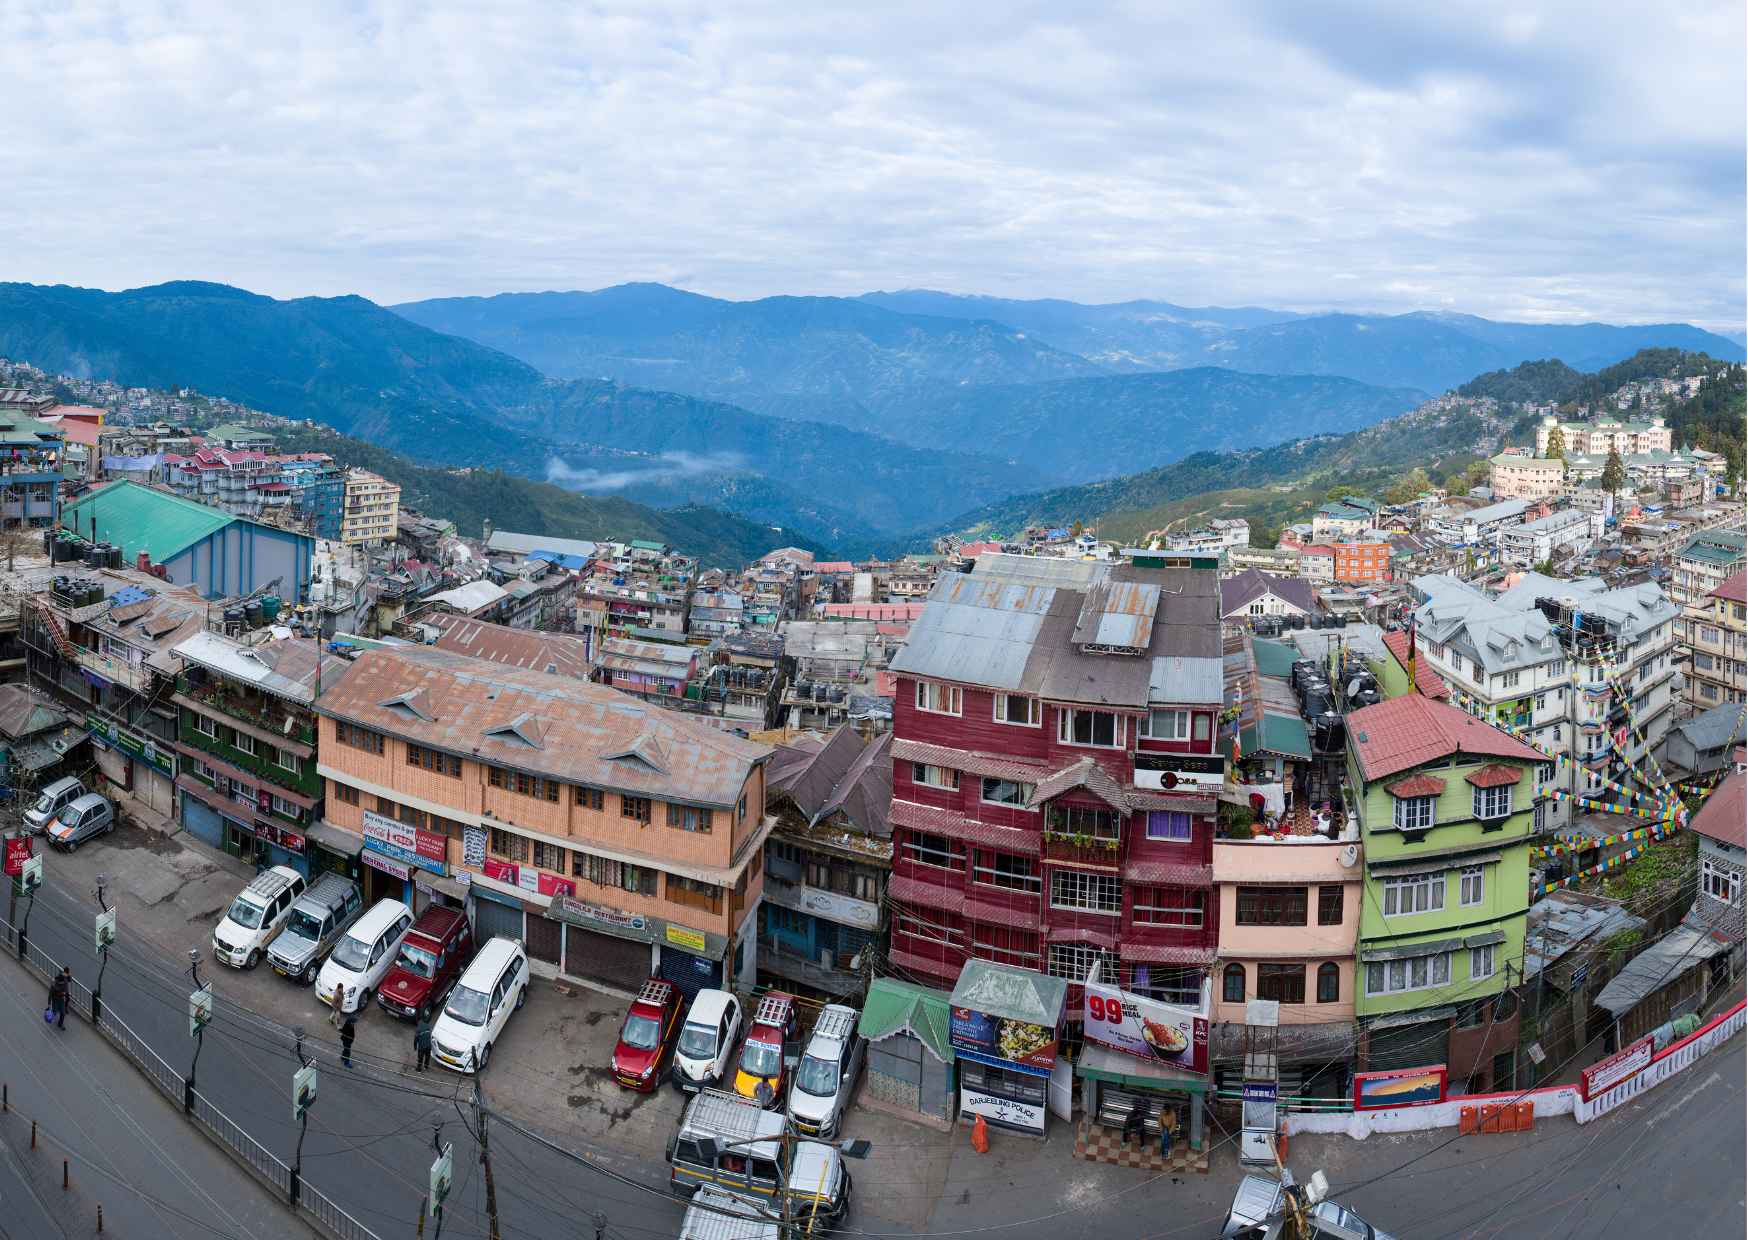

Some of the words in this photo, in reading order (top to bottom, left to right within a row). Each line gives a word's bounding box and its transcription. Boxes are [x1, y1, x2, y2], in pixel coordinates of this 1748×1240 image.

[9, 850, 28, 859] airtel
[1089, 994, 1123, 1025] 99
[1121, 1003, 1138, 1012] RICE
[1122, 1010, 1142, 1019] MEAL
[969, 1097, 1011, 1108] DARJEELING
[1011, 1103, 1035, 1119] POLICE
